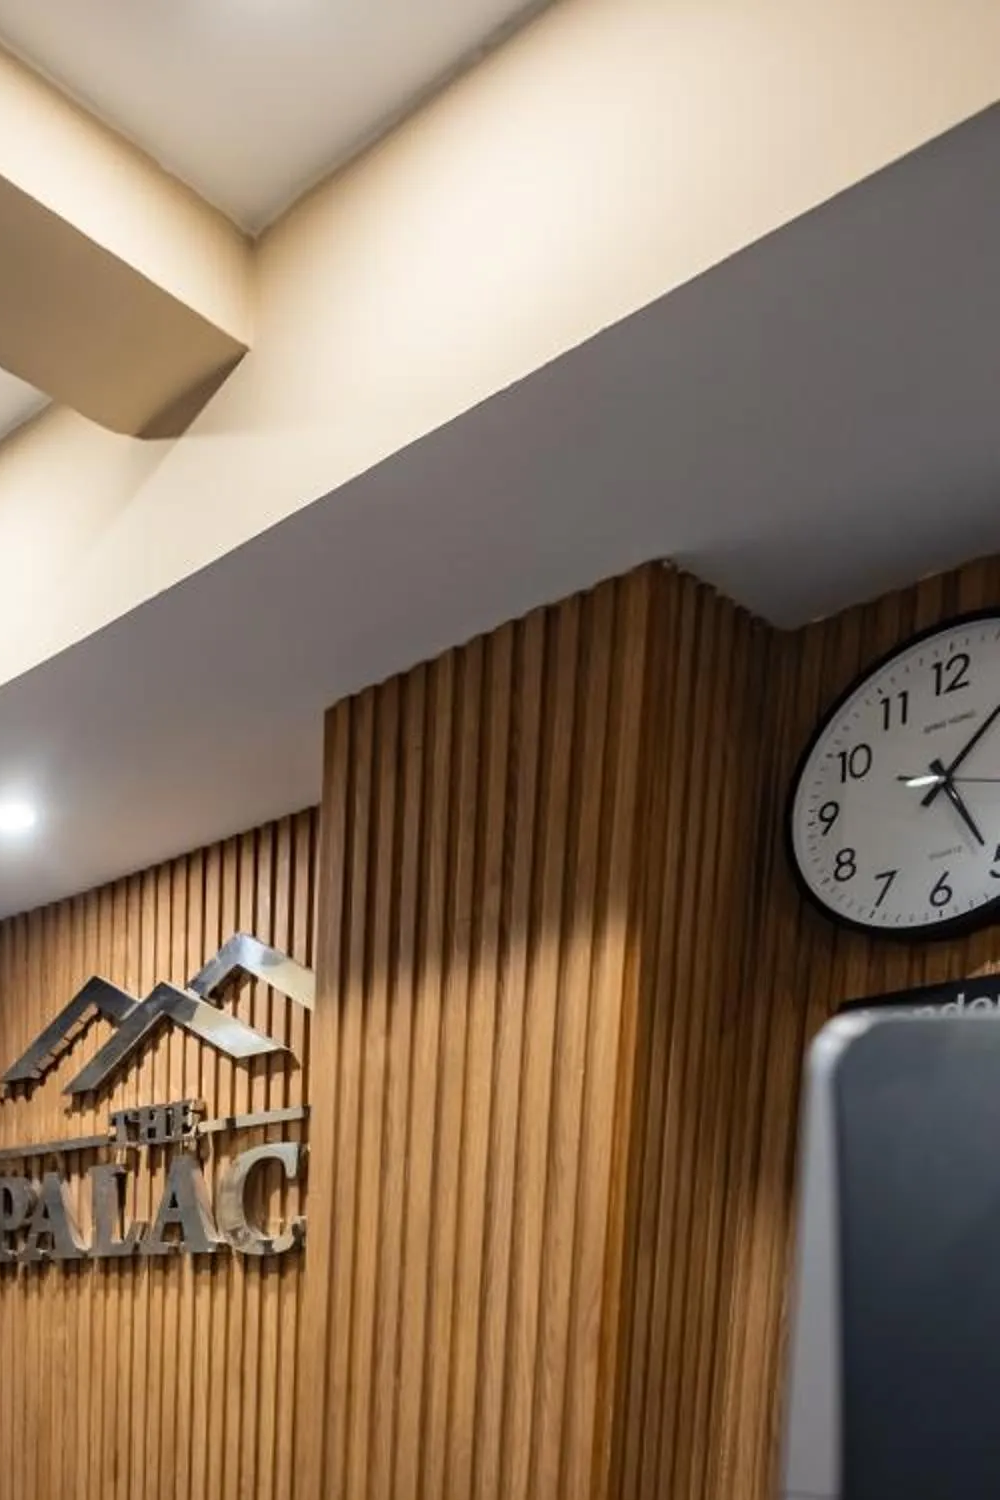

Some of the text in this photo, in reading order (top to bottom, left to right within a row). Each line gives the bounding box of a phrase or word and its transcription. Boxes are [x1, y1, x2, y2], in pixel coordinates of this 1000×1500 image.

[931, 652, 970, 696] 12
[879, 689, 909, 731] 11
[837, 742, 873, 784] 10
[818, 800, 840, 836] 9
[833, 847, 857, 882] 8
[873, 869, 899, 908] 7
[929, 870, 953, 908] 6
[108, 1098, 196, 1147] THE
